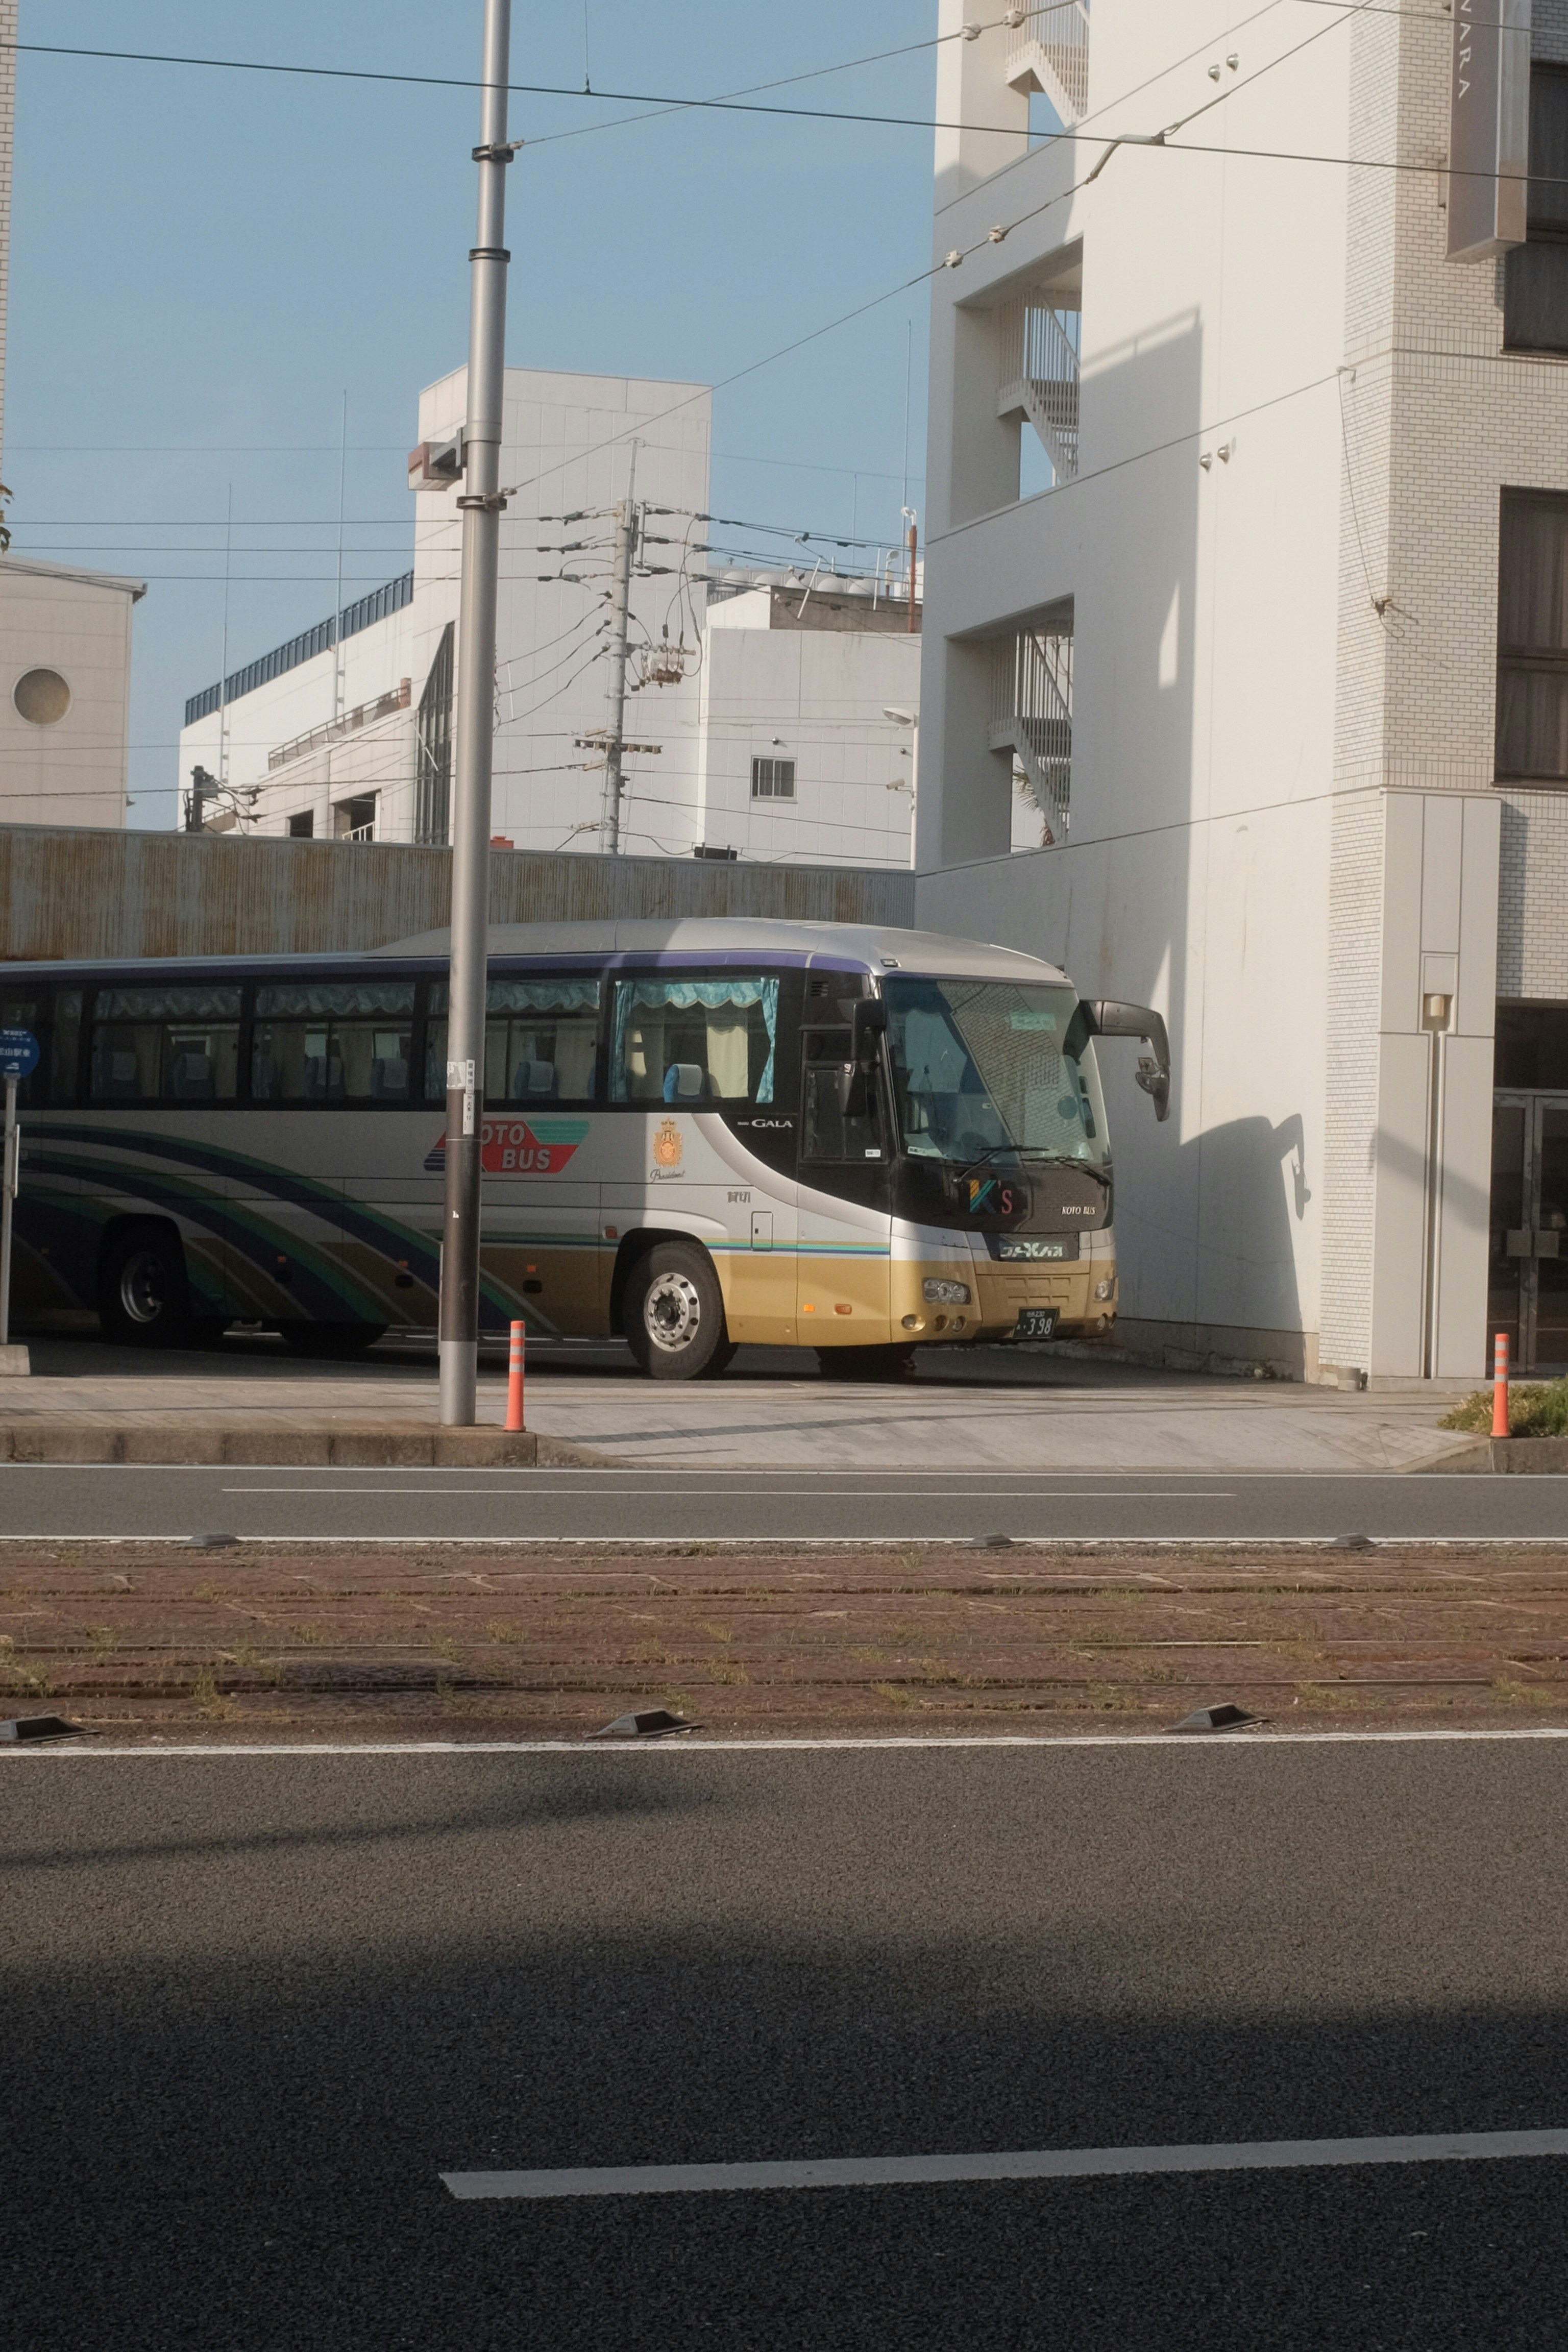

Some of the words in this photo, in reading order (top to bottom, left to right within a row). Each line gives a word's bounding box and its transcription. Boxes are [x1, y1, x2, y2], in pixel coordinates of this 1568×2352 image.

[751, 1119, 793, 1128] GALA
[481, 1124, 524, 1145] OTO
[502, 1149, 550, 1169] BUS
[1062, 1206, 1081, 1215] KOTO
[1083, 1206, 1095, 1215] BUS
